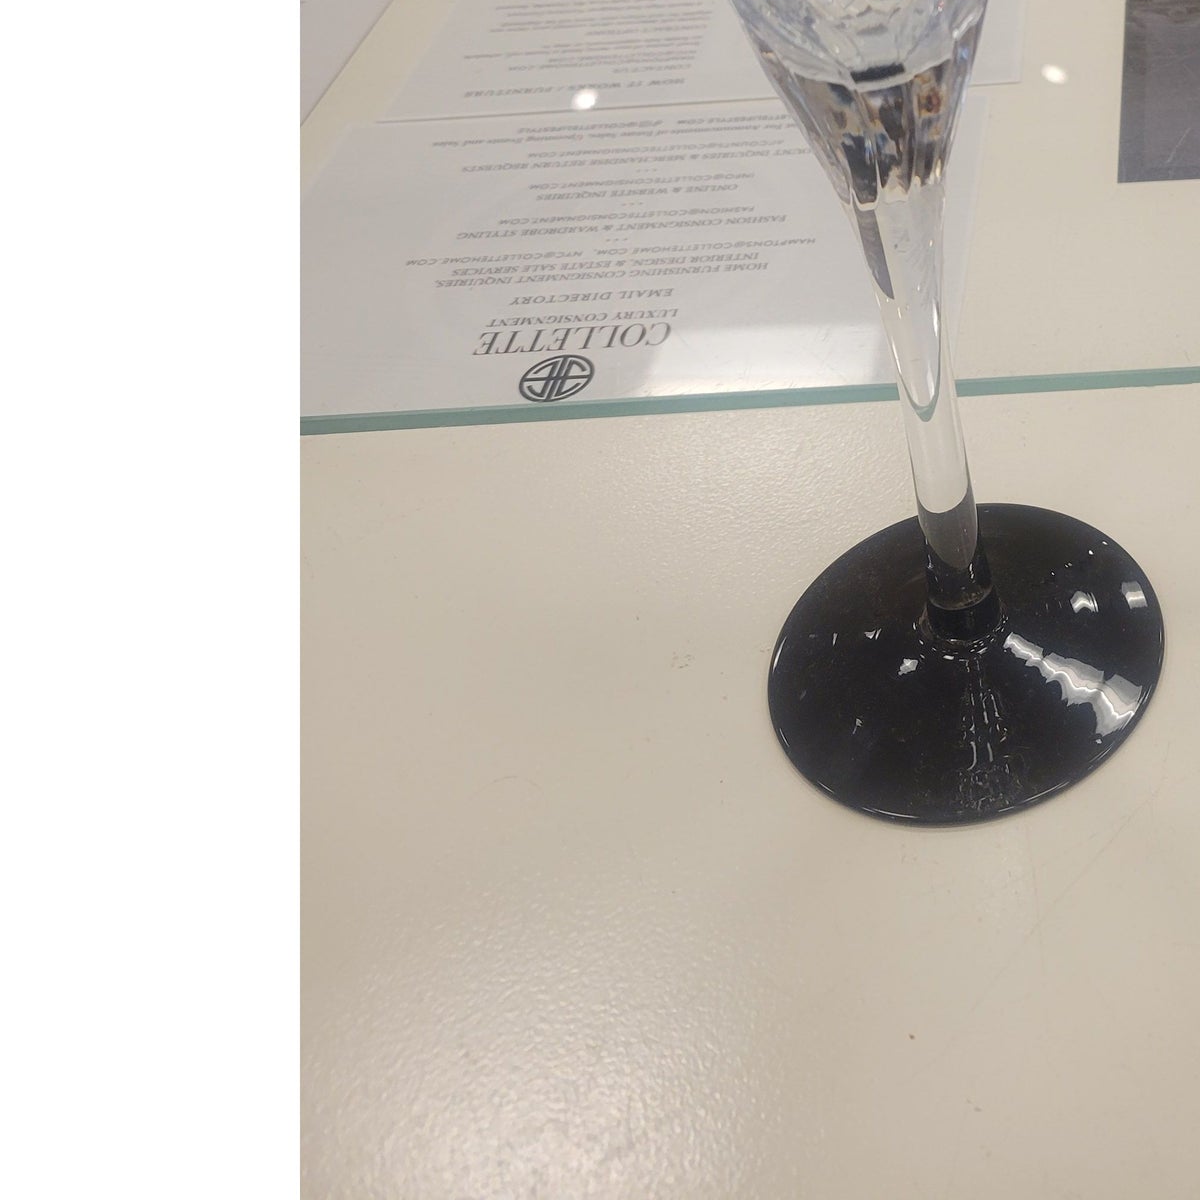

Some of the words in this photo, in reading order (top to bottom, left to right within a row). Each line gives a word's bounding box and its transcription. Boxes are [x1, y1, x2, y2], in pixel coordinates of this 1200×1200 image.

[648, 78, 686, 86] HOW
[464, 86, 554, 98] FURNITURE
[589, 154, 687, 166] MERCHANDISE
[703, 149, 770, 160] INQUIRIES
[462, 162, 529, 174] REQUESTS
[533, 159, 586, 169] RETURN
[610, 188, 668, 198] WEBSITE
[685, 184, 738, 194] ONLINE
[536, 190, 607, 201] INQUIRIES
[616, 218, 722, 231] CONSIGNMENT
[726, 214, 787, 226] FASHION
[456, 230, 517, 240] STYLING
[520, 225, 599, 237] WARDROBE
[690, 252, 759, 264] INTERIOR
[452, 266, 519, 276] SERVICES
[522, 264, 557, 272] SALE
[560, 260, 611, 271] ESTATE
[629, 264, 720, 278] FURNISHING
[723, 262, 768, 272] HOME
[515, 270, 626, 284] CONSIGNMENT
[509, 291, 612, 306] DIRECTORY
[615, 288, 674, 301] EMAIL
[485, 312, 607, 328] CONSIGNMENT
[610, 308, 678, 321] LUXURY
[472, 322, 672, 355] COLLETTE
